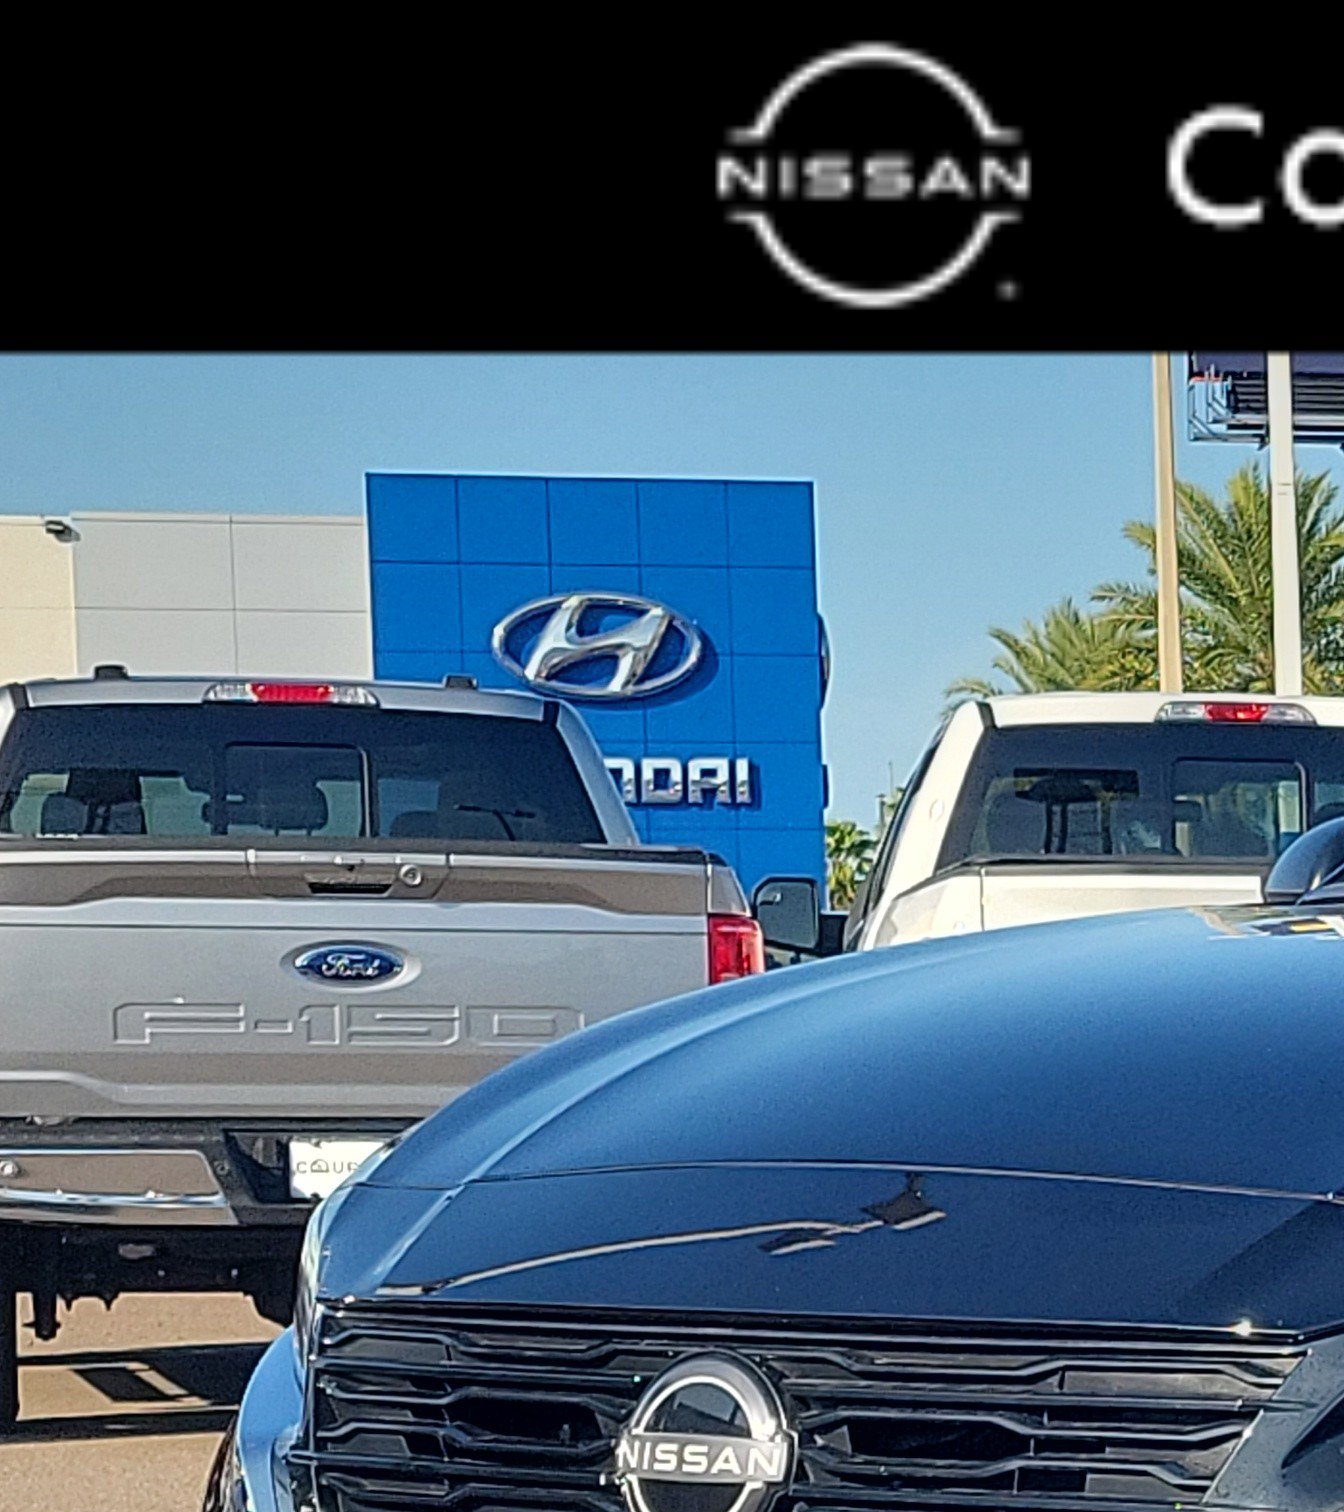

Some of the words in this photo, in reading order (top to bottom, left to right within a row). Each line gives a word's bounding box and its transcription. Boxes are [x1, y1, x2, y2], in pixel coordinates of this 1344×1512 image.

[321, 952, 381, 978] Ford
[112, 1001, 586, 1047] F-150
[616, 1437, 779, 1477] NISSAN
